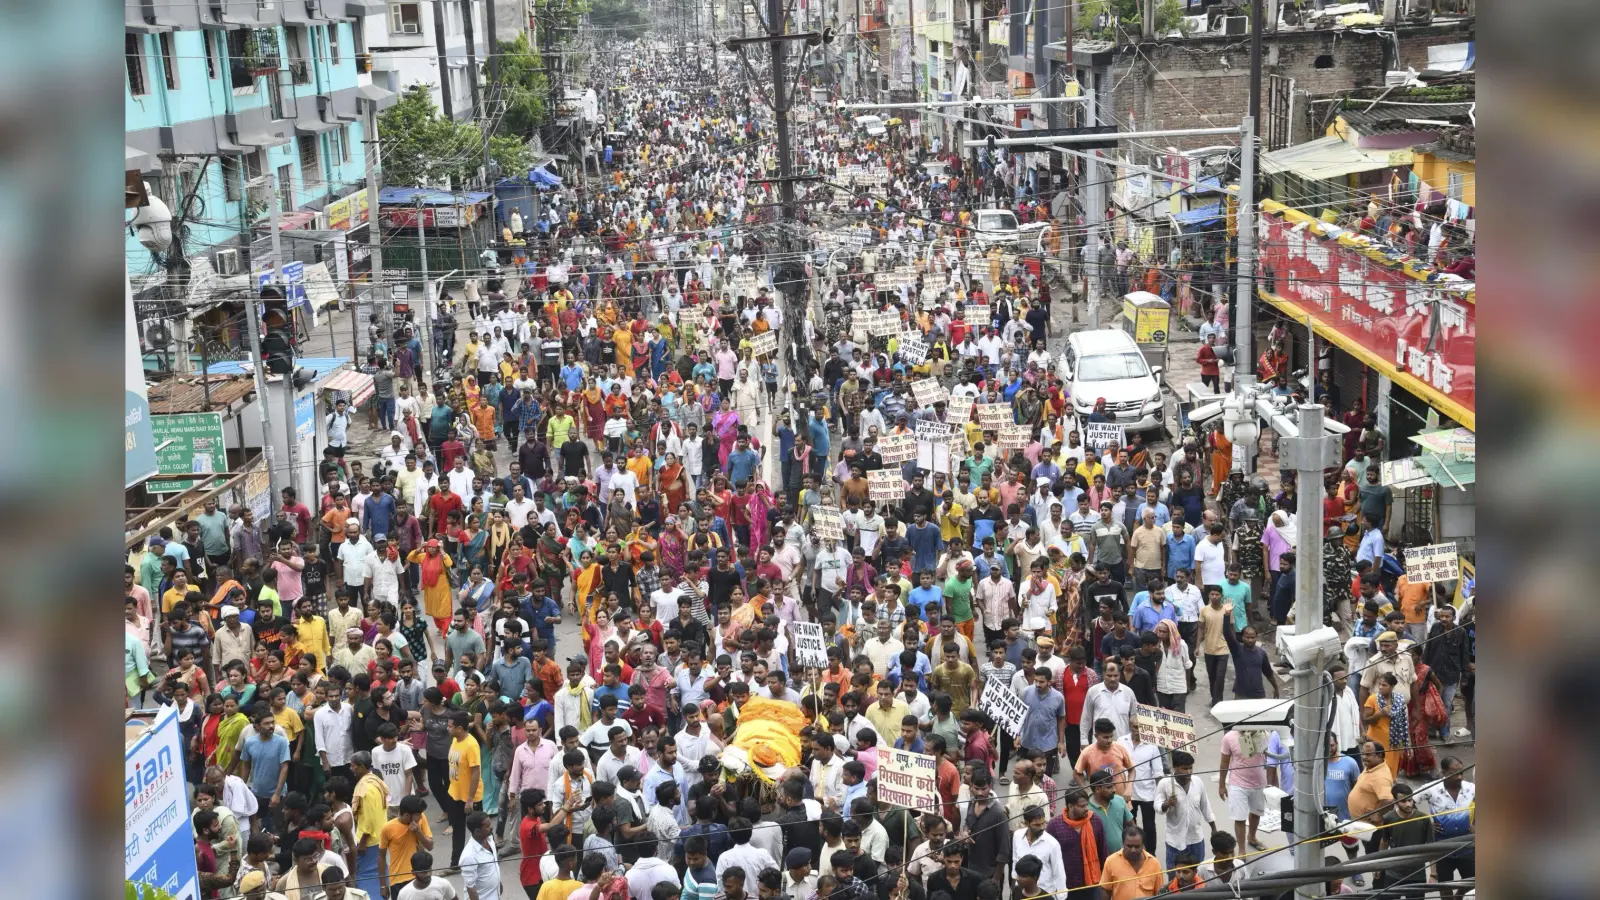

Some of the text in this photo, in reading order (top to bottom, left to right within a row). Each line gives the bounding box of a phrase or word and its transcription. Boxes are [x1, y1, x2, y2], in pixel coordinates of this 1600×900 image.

[902, 337, 929, 351] WE WANT
[902, 345, 925, 358] JUSTICE
[916, 419, 950, 430] WE WANT
[917, 426, 947, 435] JUSTICE
[1088, 423, 1121, 432] WE WANT
[1089, 431, 1119, 440] JUSTICE
[161, 481, 182, 489] COLLEGE
[794, 622, 820, 637] WE WANT
[797, 637, 822, 651] JUSTICE
[989, 675, 1028, 715] WE WANT
[985, 690, 1021, 725] JUSTICE
[878, 764, 935, 793] गिरफ्तार करो
[133, 766, 174, 810] HOSPITAL
[878, 783, 935, 812] गिरफ्तार करो
[144, 800, 178, 844] अस्पताल
